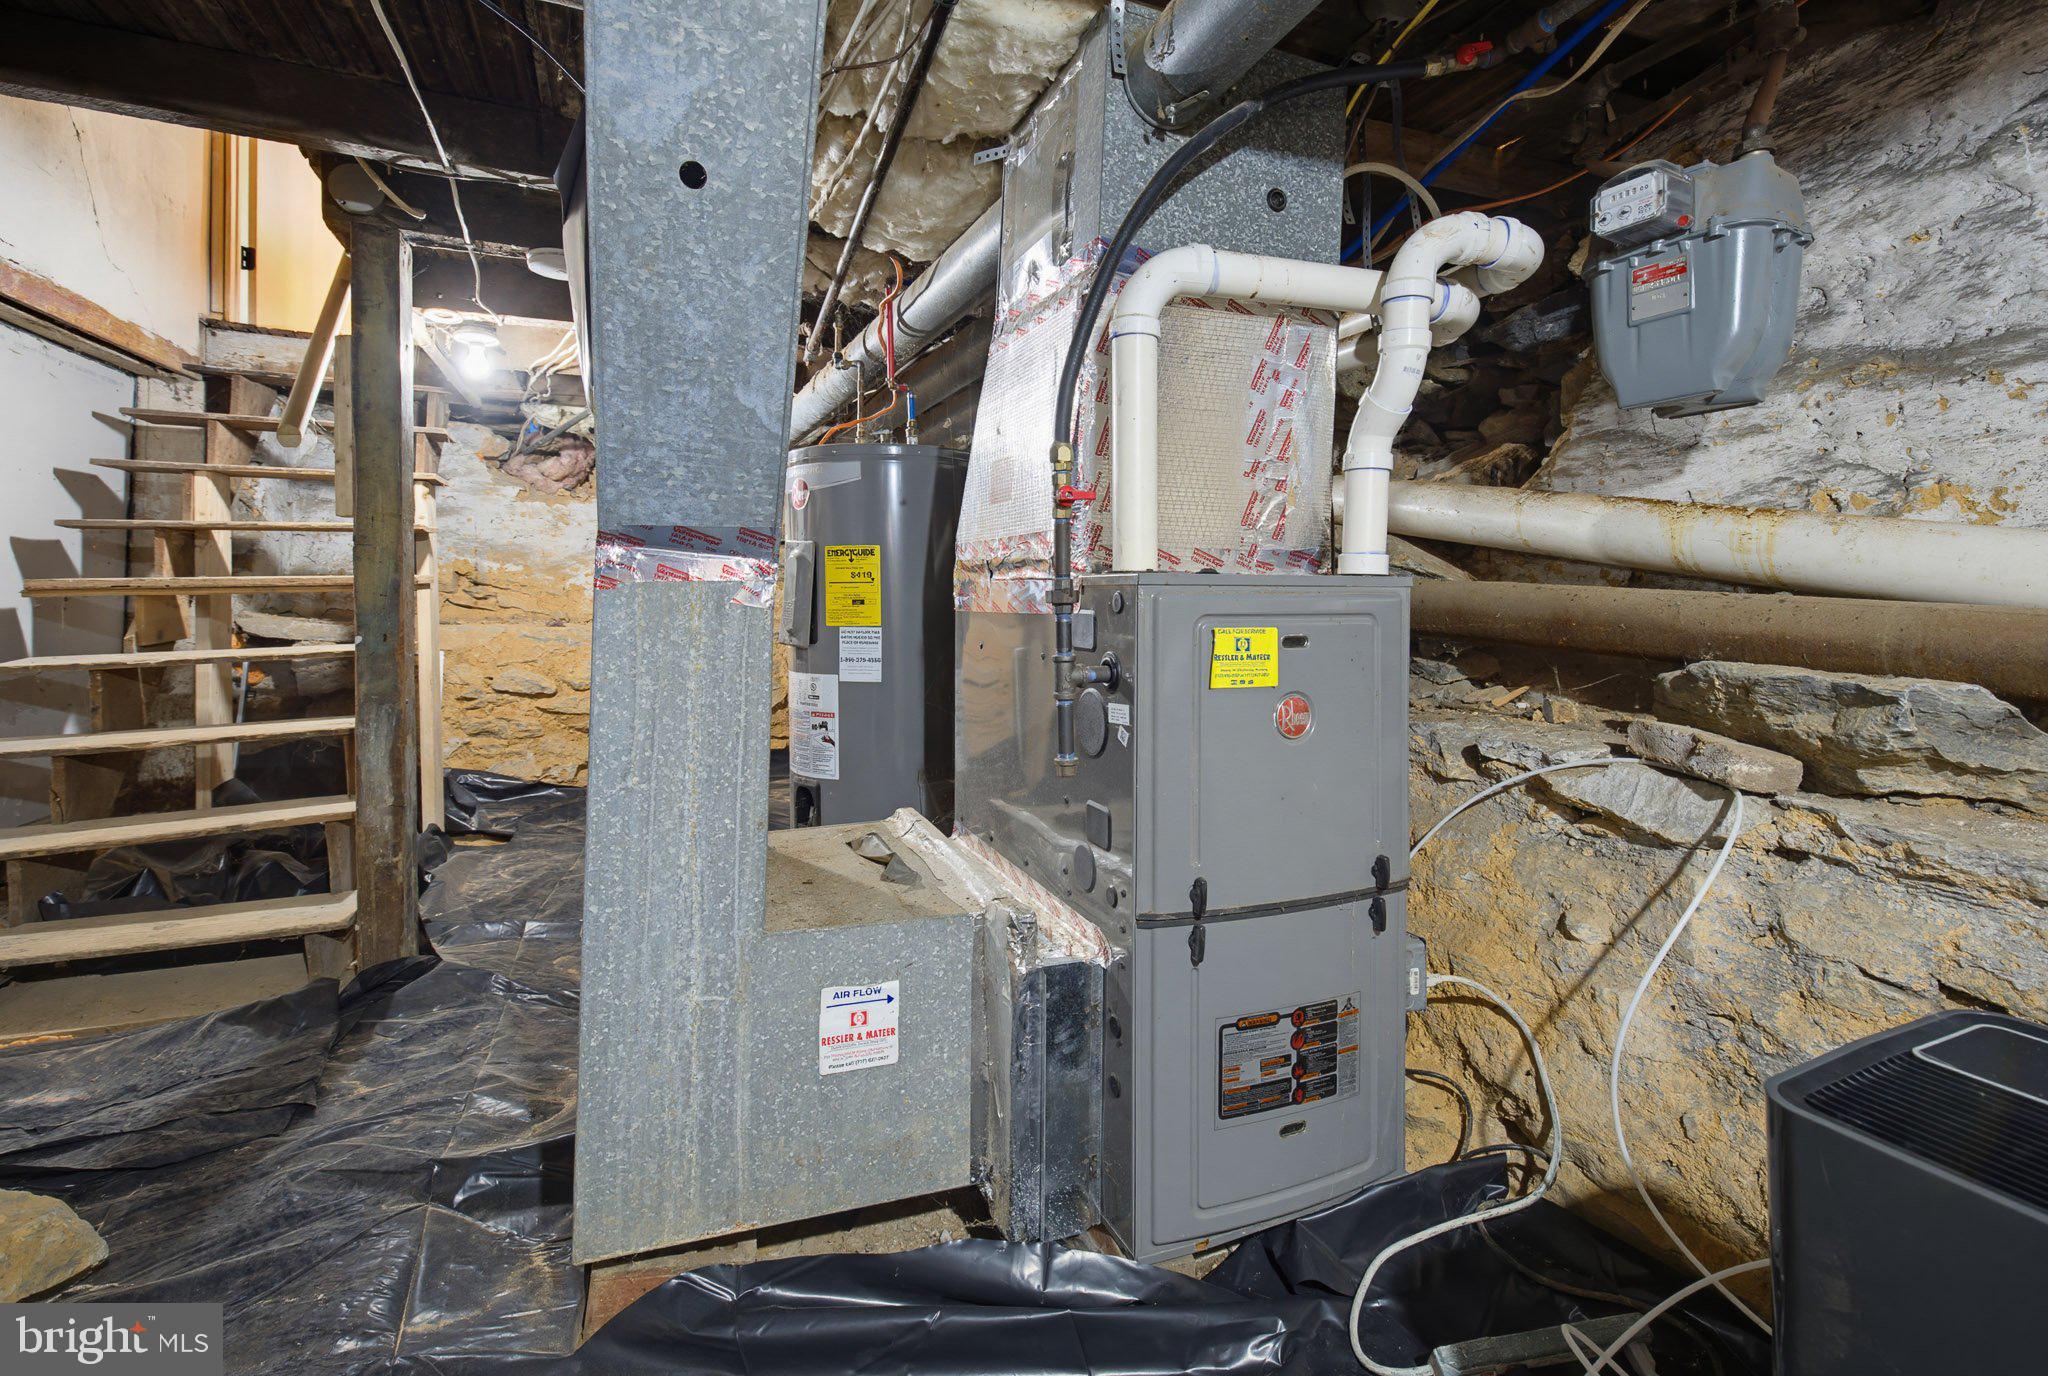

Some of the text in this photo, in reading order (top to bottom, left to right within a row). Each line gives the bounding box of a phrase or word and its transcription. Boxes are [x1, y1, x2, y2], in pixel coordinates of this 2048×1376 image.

[833, 986, 882, 1000] AIR FLOW
[821, 1033, 854, 1047] RESSLER
[857, 1032, 863, 1041] &
[865, 1027, 896, 1040] MATEER
